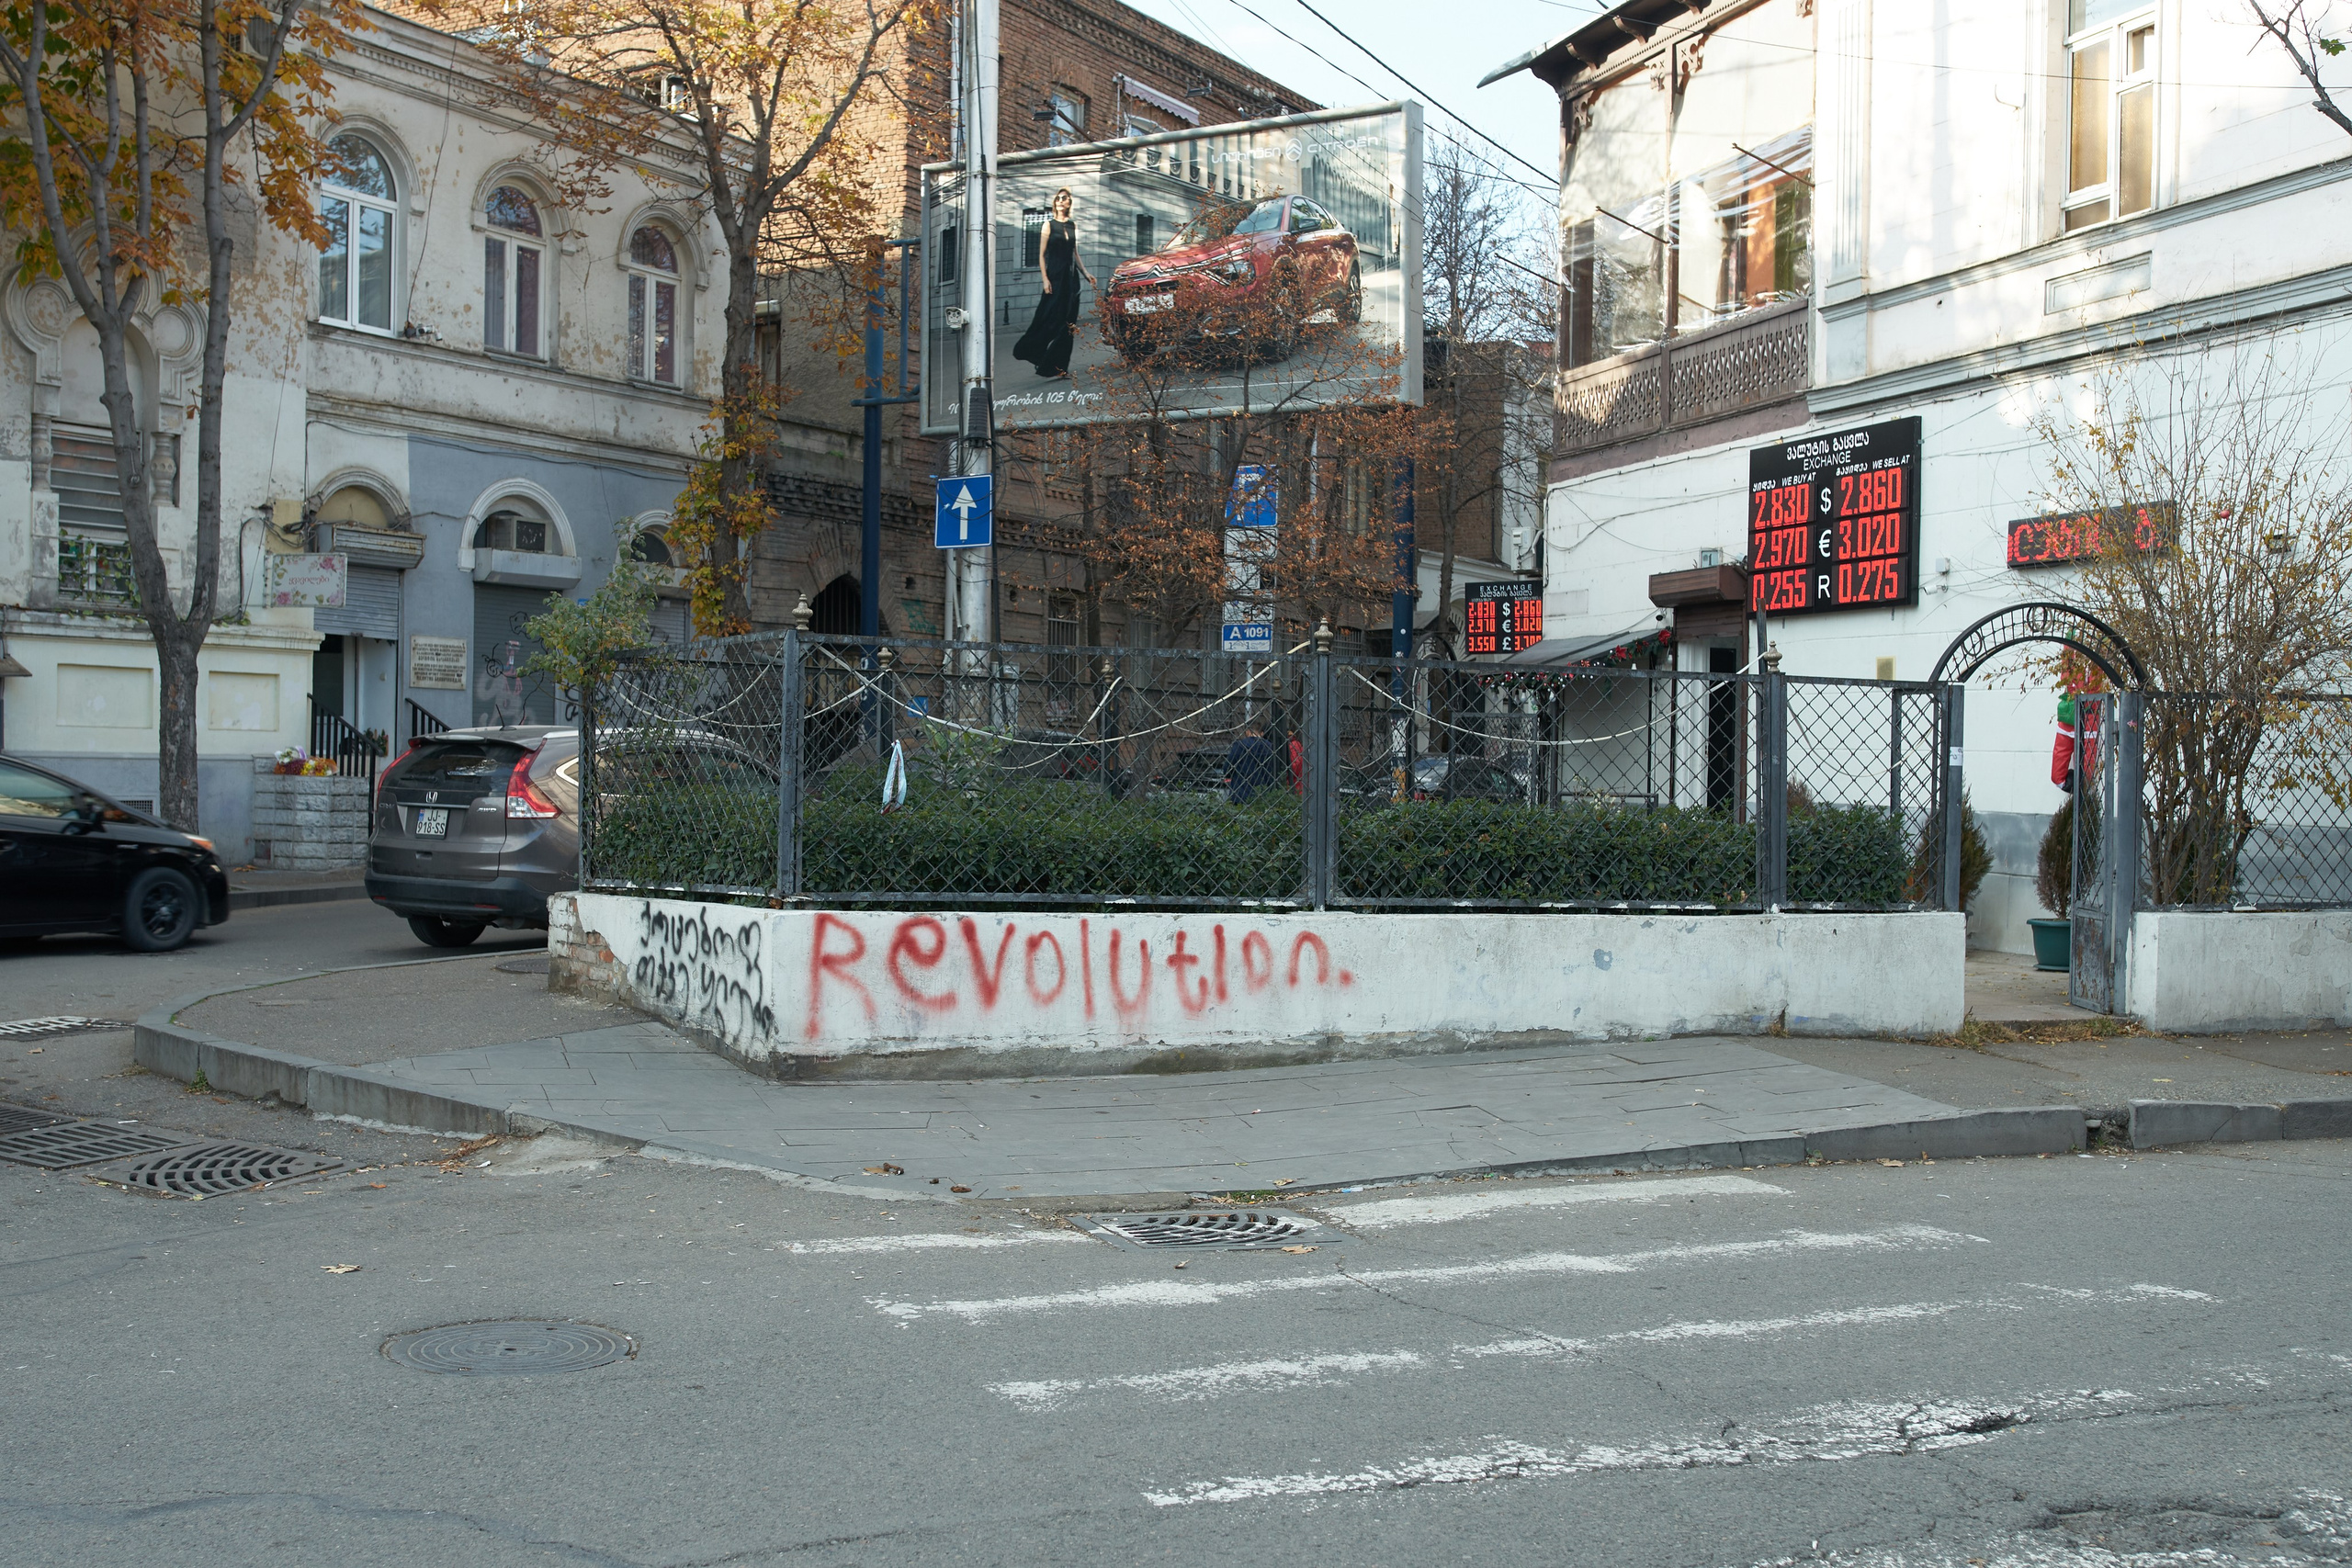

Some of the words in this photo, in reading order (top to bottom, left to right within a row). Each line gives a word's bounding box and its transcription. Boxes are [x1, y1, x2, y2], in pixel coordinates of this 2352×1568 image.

[1306, 136, 1379, 153] CITROËN
[1046, 391, 1065, 403] 105
[1786, 442, 1829, 461] ვალუტის
[1832, 431, 1870, 450] გაცვლა
[1803, 450, 1851, 471] EXCHANGE
[1836, 462, 1868, 476] გაყიდვა
[1872, 458, 1883, 469] WE
[1883, 457, 1901, 468] SELL
[1900, 455, 1910, 465] AT
[1752, 479, 1776, 491] ყიდვა
[1781, 475, 1792, 486] WE
[1792, 473, 1807, 485] BUY
[1806, 471, 1816, 482] AT
[1754, 483, 1810, 529] 2.830
[1820, 487, 1832, 514] $
[1840, 467, 1902, 516] 2.860
[1754, 525, 1808, 569] 2.970
[1818, 529, 1831, 558] €
[1838, 513, 1901, 559] 3.020
[1479, 583, 1532, 592] EXCHANGE
[1752, 568, 1806, 612] 0.255
[1818, 575, 1831, 598] R
[1838, 558, 1899, 604] 0.275
[1468, 601, 1496, 618] 2.830
[1502, 602, 1510, 616] $
[1514, 600, 1542, 617] 2.860
[1229, 626, 1241, 639] A
[1244, 626, 1269, 638] 1091
[1468, 618, 1496, 633] 2.970
[1502, 619, 1511, 633] €
[1514, 617, 1542, 632] 3.020
[1468, 636, 1496, 651] 3.550
[1502, 637, 1511, 650] £
[417, 822, 445, 835] 918-SS
